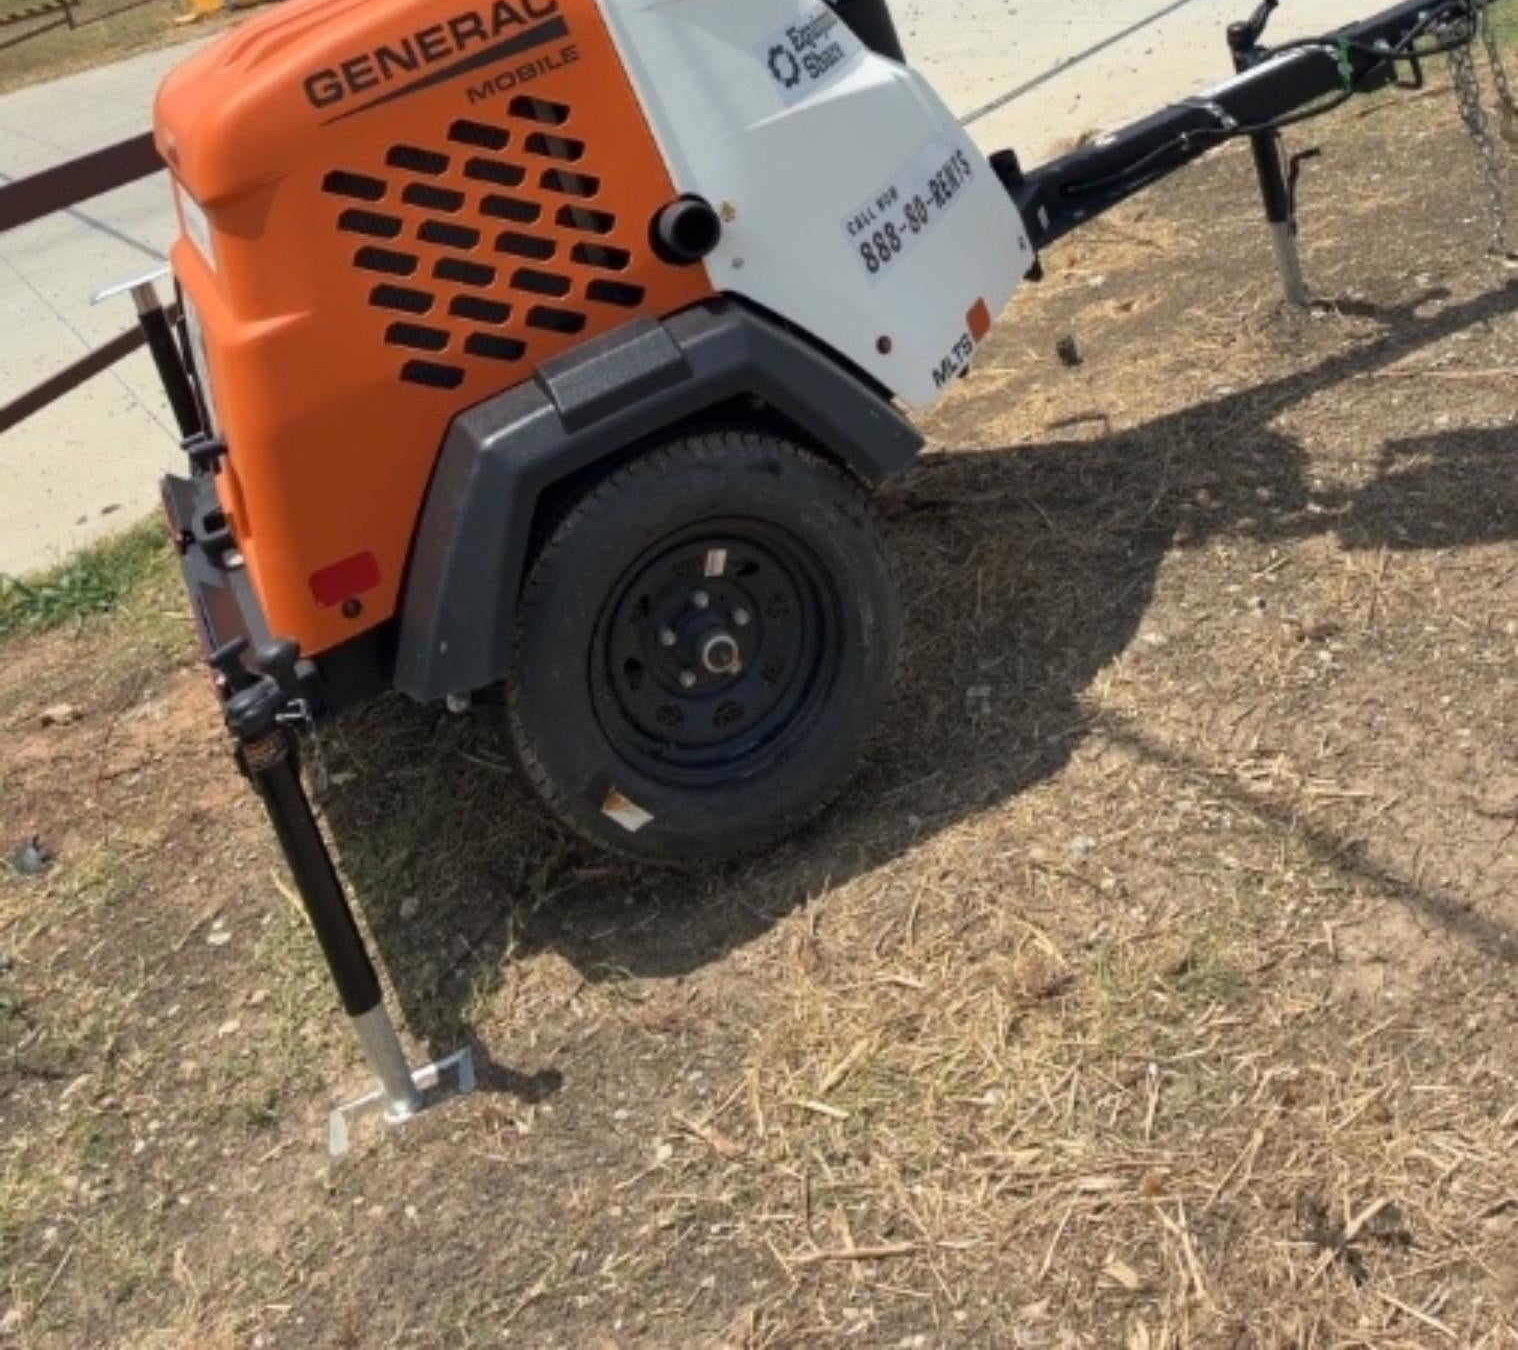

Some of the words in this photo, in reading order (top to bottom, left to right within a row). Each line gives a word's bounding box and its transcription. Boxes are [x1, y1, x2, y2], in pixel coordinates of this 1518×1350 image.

[466, 44, 581, 104] MOBILE
[846, 207, 877, 237] CALL
[932, 333, 975, 388] MLTS
